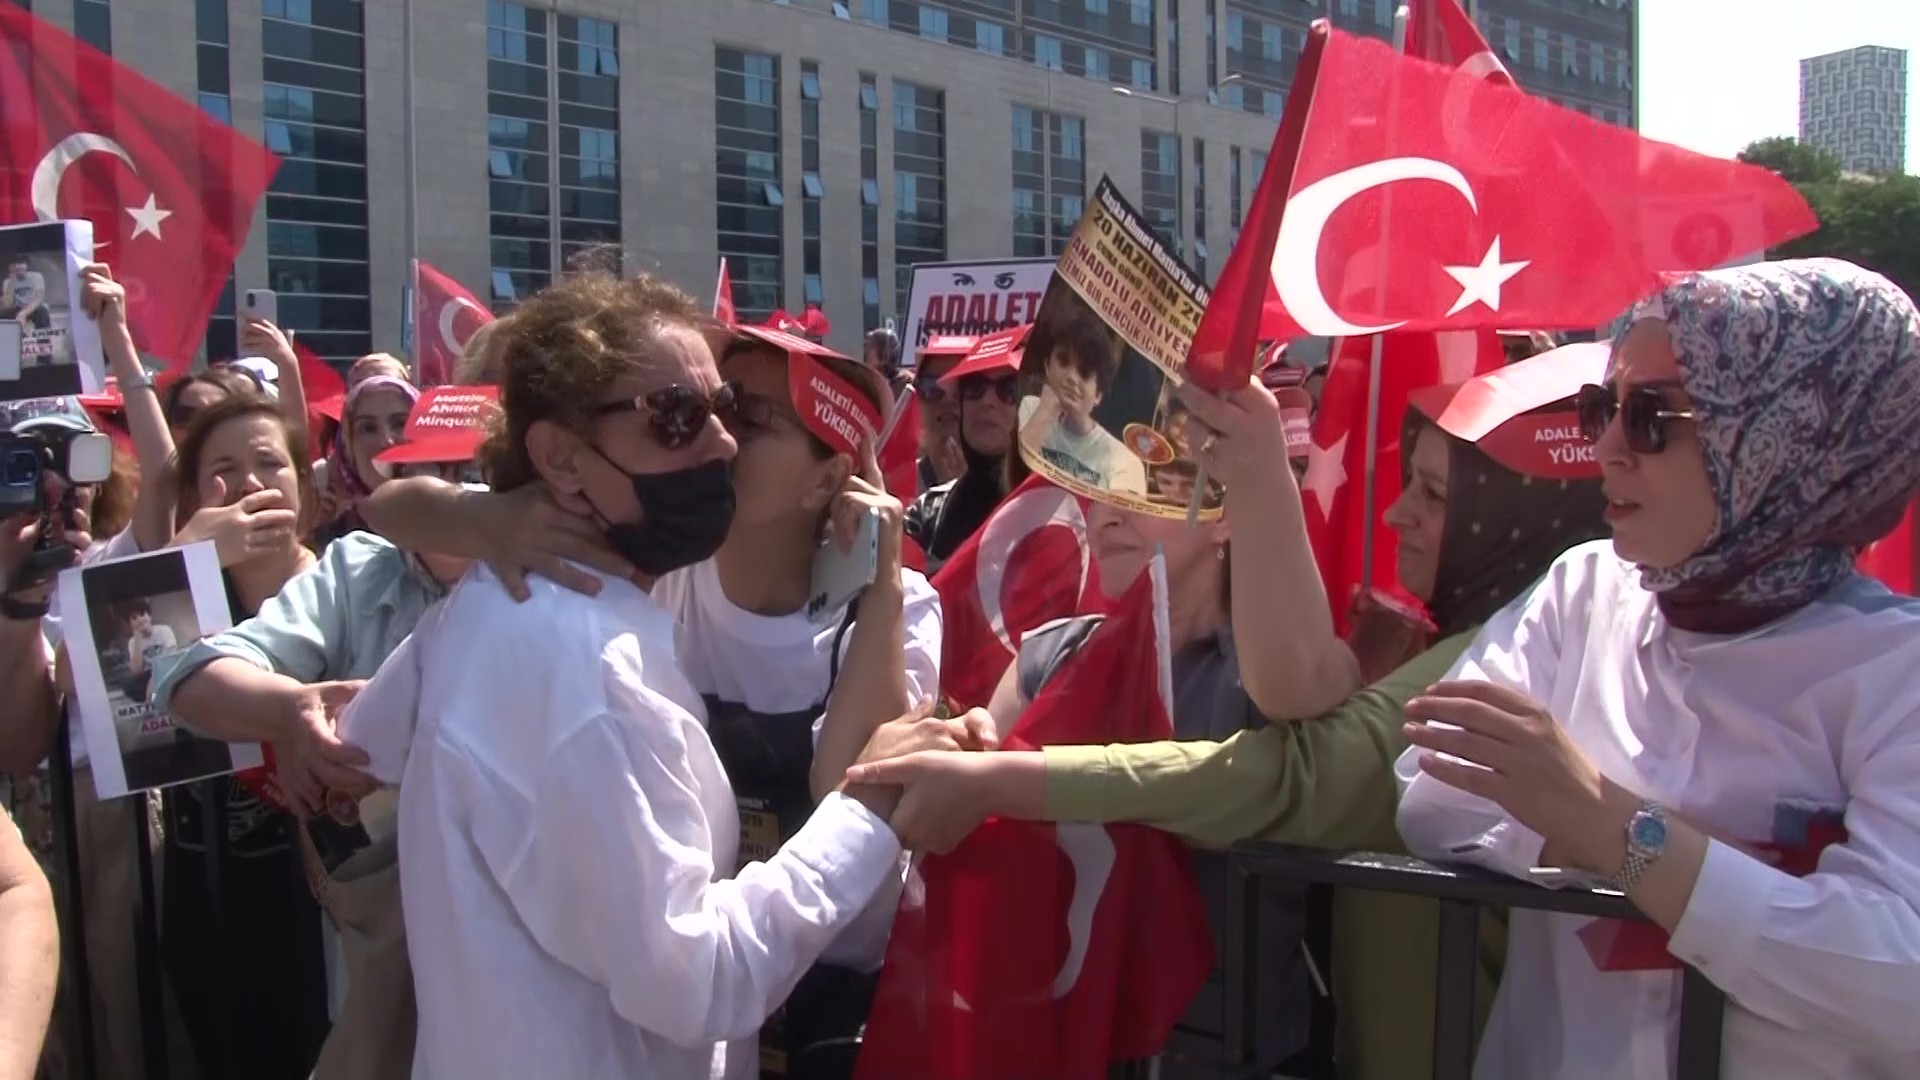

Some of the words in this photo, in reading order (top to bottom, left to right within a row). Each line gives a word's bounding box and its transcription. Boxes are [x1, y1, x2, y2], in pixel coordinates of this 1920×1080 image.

[1092, 208, 1112, 237] 20
[1072, 236, 1130, 303] ANADOLU
[925, 291, 1042, 326] ADALET
[1085, 279, 1102, 305] BİR
[809, 376, 853, 412] ADALETİ
